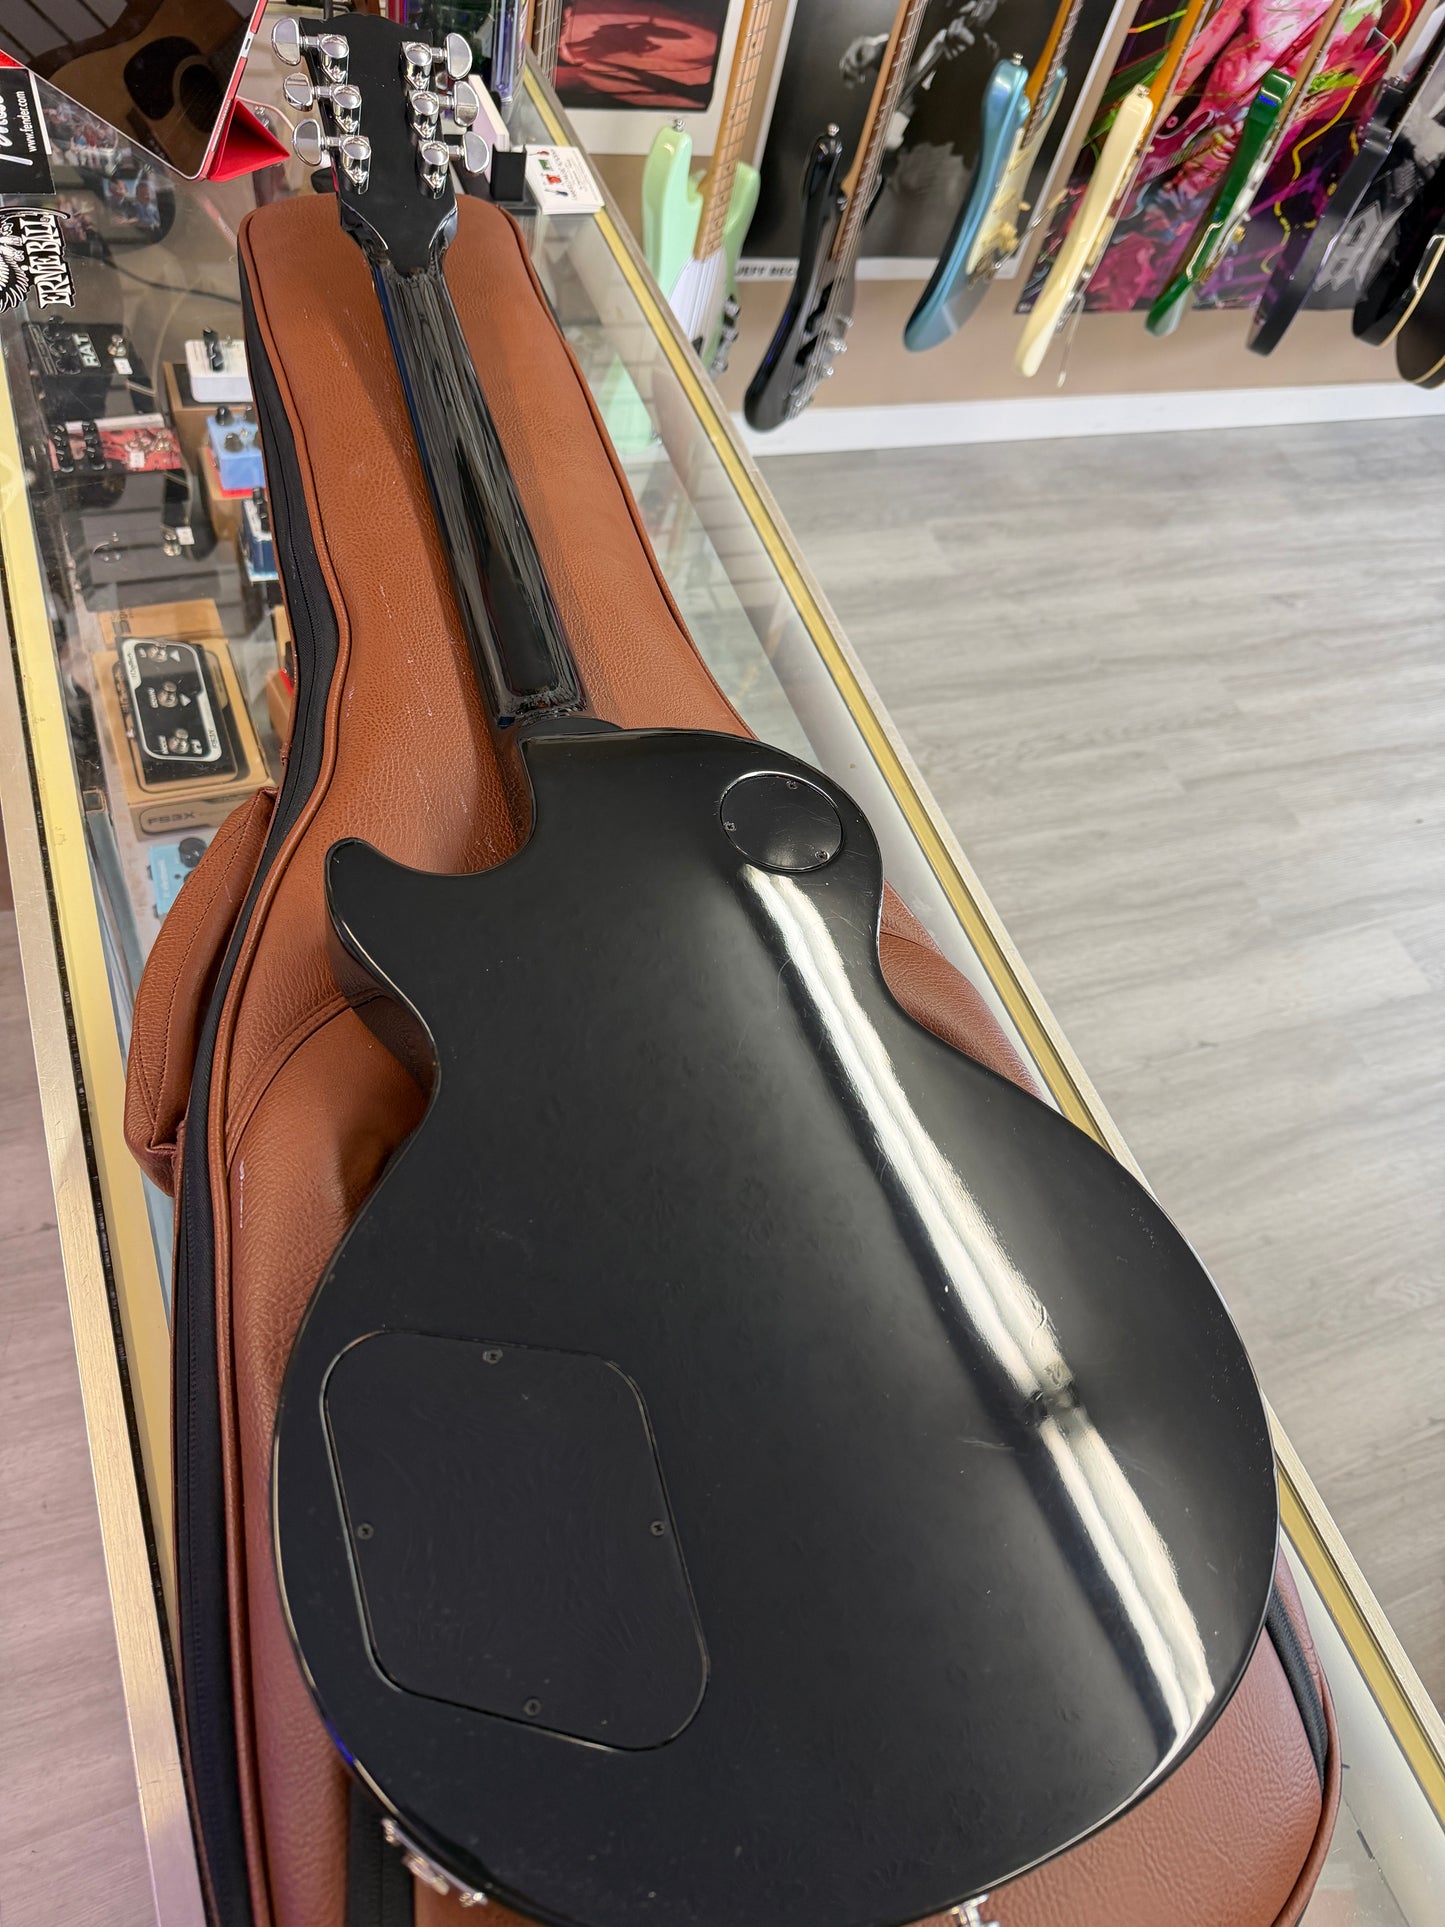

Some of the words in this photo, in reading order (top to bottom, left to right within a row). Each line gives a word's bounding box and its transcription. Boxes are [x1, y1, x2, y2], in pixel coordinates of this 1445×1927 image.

[16, 91, 37, 152] www.fender.com
[19, 214, 62, 255] BALL
[21, 255, 72, 309] ERNIE
[769, 266, 797, 277] BEC
[72, 333, 101, 367] RAT
